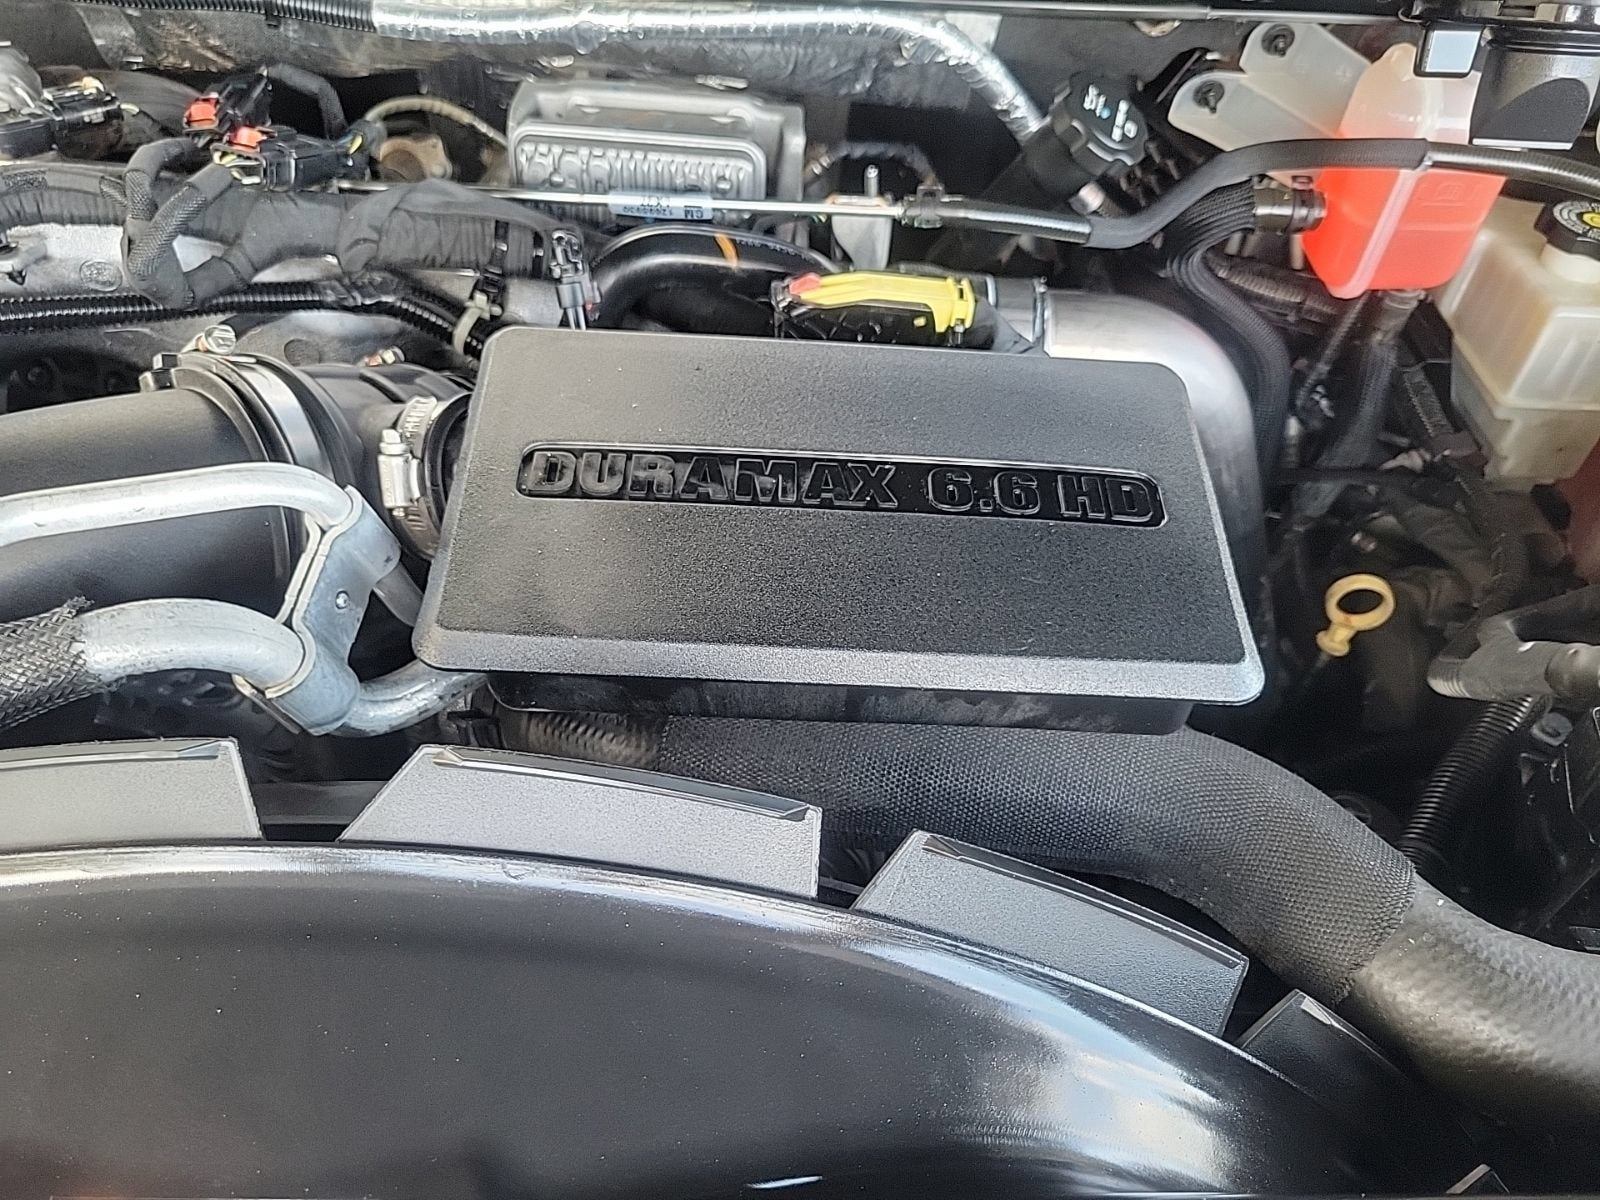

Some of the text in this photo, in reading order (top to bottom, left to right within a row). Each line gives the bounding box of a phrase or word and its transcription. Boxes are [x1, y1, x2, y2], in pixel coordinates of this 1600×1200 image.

[526, 451, 1154, 521] DURAMAX 6.6 HD
